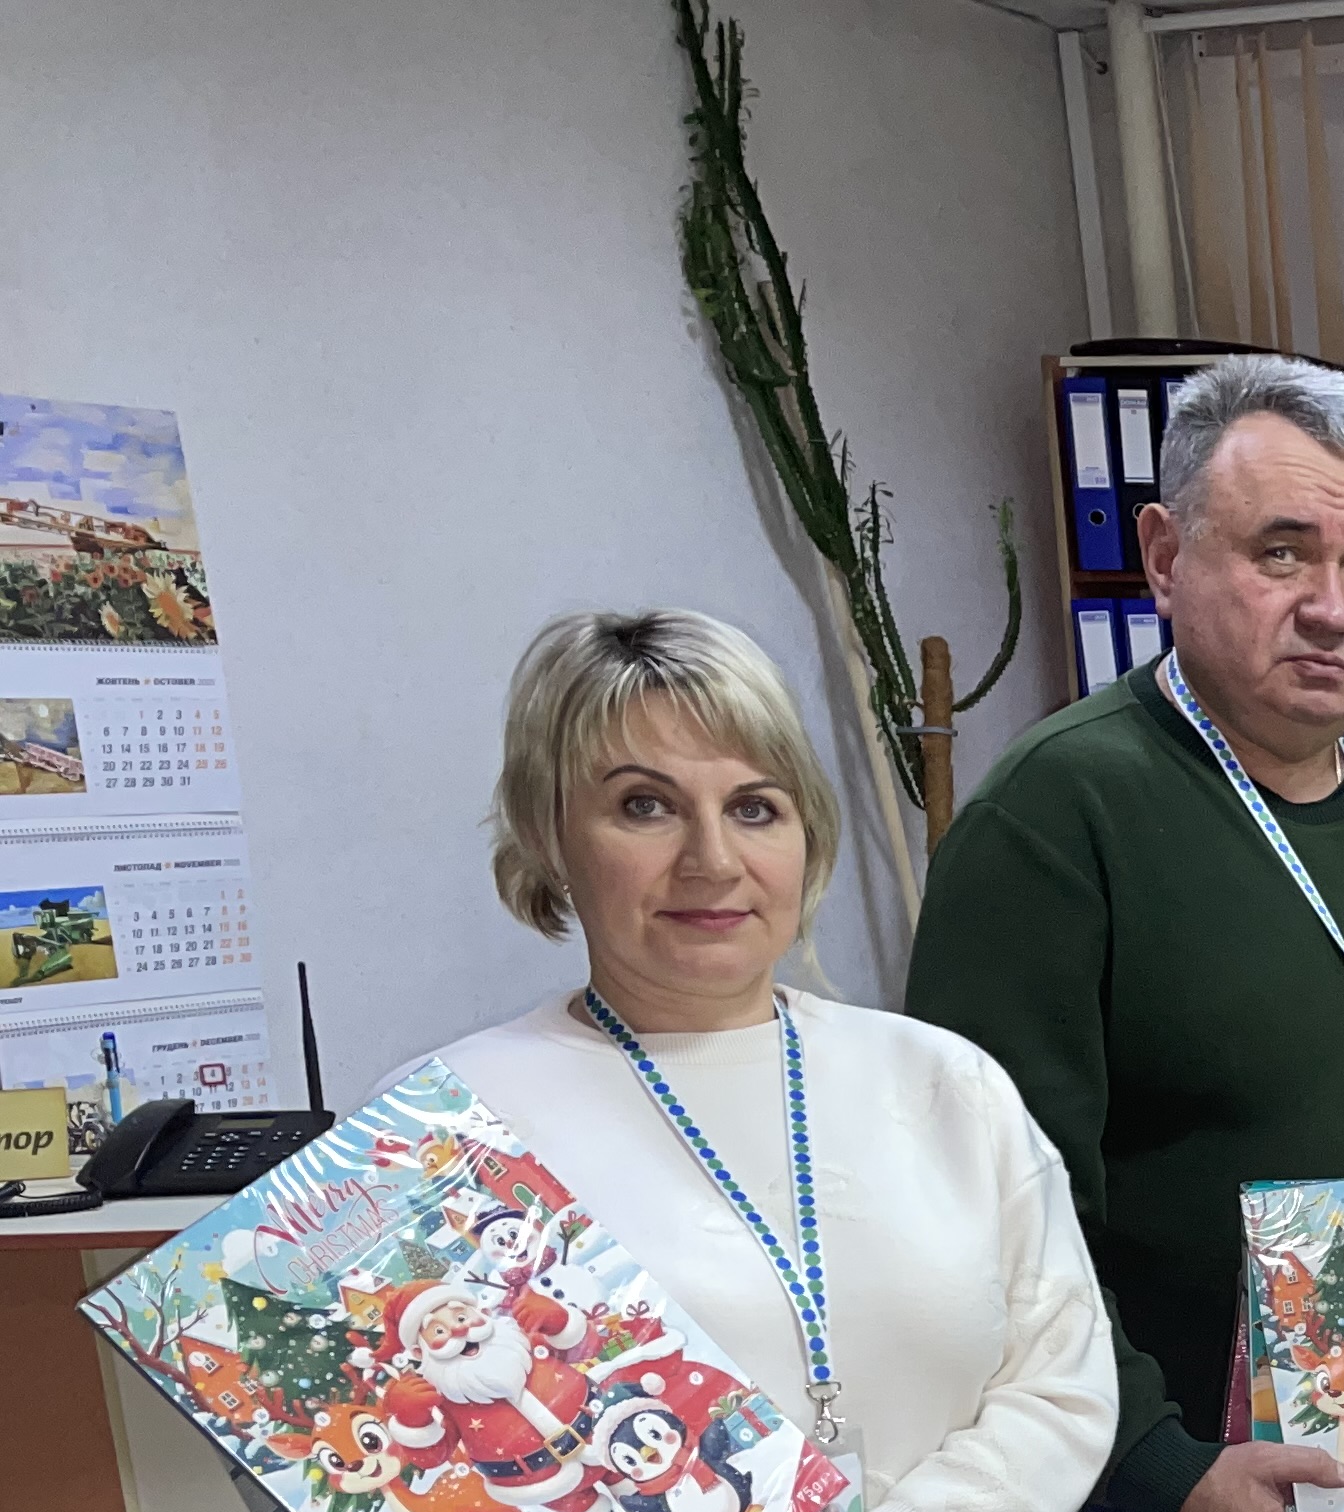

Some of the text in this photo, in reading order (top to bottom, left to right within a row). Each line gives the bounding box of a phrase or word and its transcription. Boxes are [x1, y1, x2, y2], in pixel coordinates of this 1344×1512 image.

[157, 710, 163, 720] 2
[176, 710, 182, 720] 3
[103, 726, 110, 737] 6
[122, 726, 129, 736] 7
[173, 726, 185, 736] 10
[102, 743, 112, 754] 13
[121, 743, 131, 753] 14
[139, 743, 150, 753] 15
[176, 742, 187, 752] 17
[102, 761, 116, 771] 20
[121, 760, 133, 771] 21
[140, 760, 152, 771] 22
[158, 760, 171, 770] 23
[177, 759, 189, 770] 24
[105, 776, 191, 788] 27 28 29 30 31
[133, 912, 140, 922] 3
[151, 911, 157, 920] 4
[169, 909, 175, 919] 5
[204, 907, 210, 916] 7
[132, 928, 143, 939] 10
[167, 926, 177, 936] 12
[184, 925, 195, 935] 13
[202, 924, 212, 933] 14
[135, 945, 145, 955] 17
[152, 944, 163, 954] 18
[185, 941, 197, 952] 20
[203, 940, 214, 950] 21
[136, 962, 148, 972] 24
[153, 960, 165, 970] 25
[188, 957, 200, 968] 27
[205, 956, 217, 966] 28
[176, 1073, 183, 1084] 2
[192, 1087, 202, 1096] 10
[287, 1199, 399, 1284] CHRISTMAS
